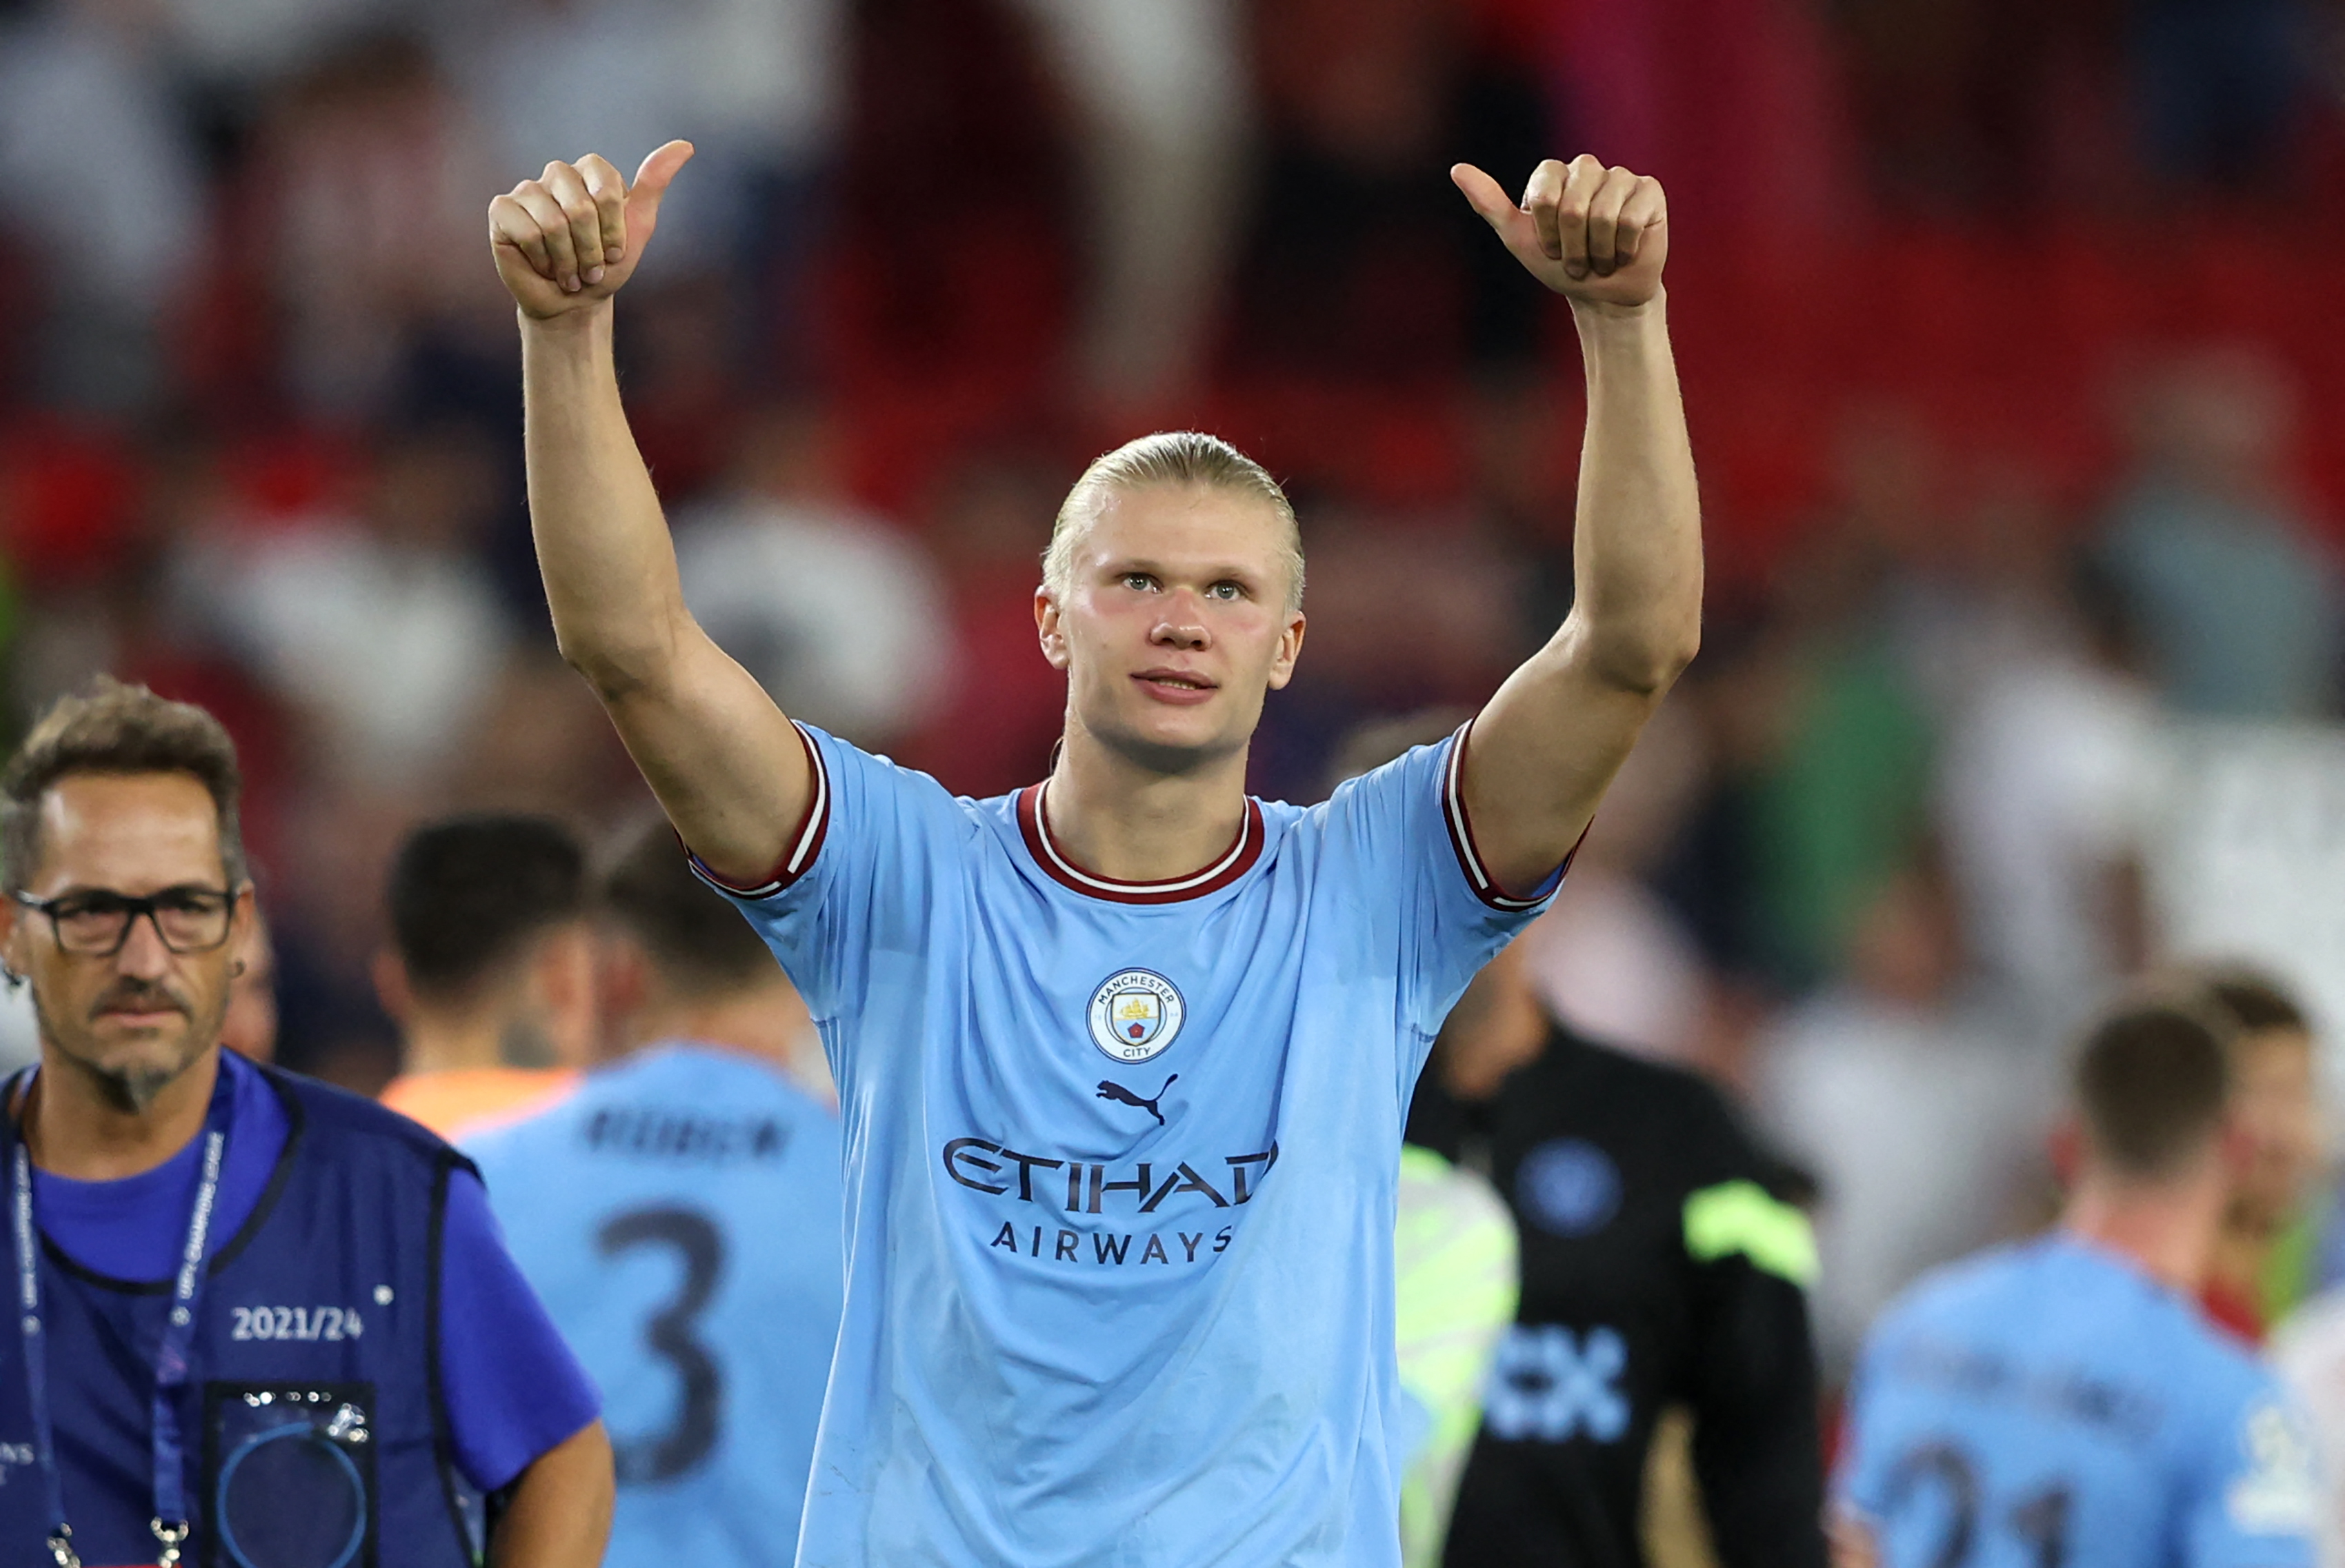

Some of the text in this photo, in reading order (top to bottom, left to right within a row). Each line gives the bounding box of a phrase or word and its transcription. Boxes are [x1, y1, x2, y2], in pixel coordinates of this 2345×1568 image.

[1098, 976, 1175, 1005] MANCHESTER
[1123, 1047, 1150, 1057] CITY
[943, 1138, 1279, 1214] ETIHAD
[990, 1221, 1232, 1265] AIRWAYS
[231, 1305, 363, 1340] 2021/24
[596, 1200, 727, 1488] 3
